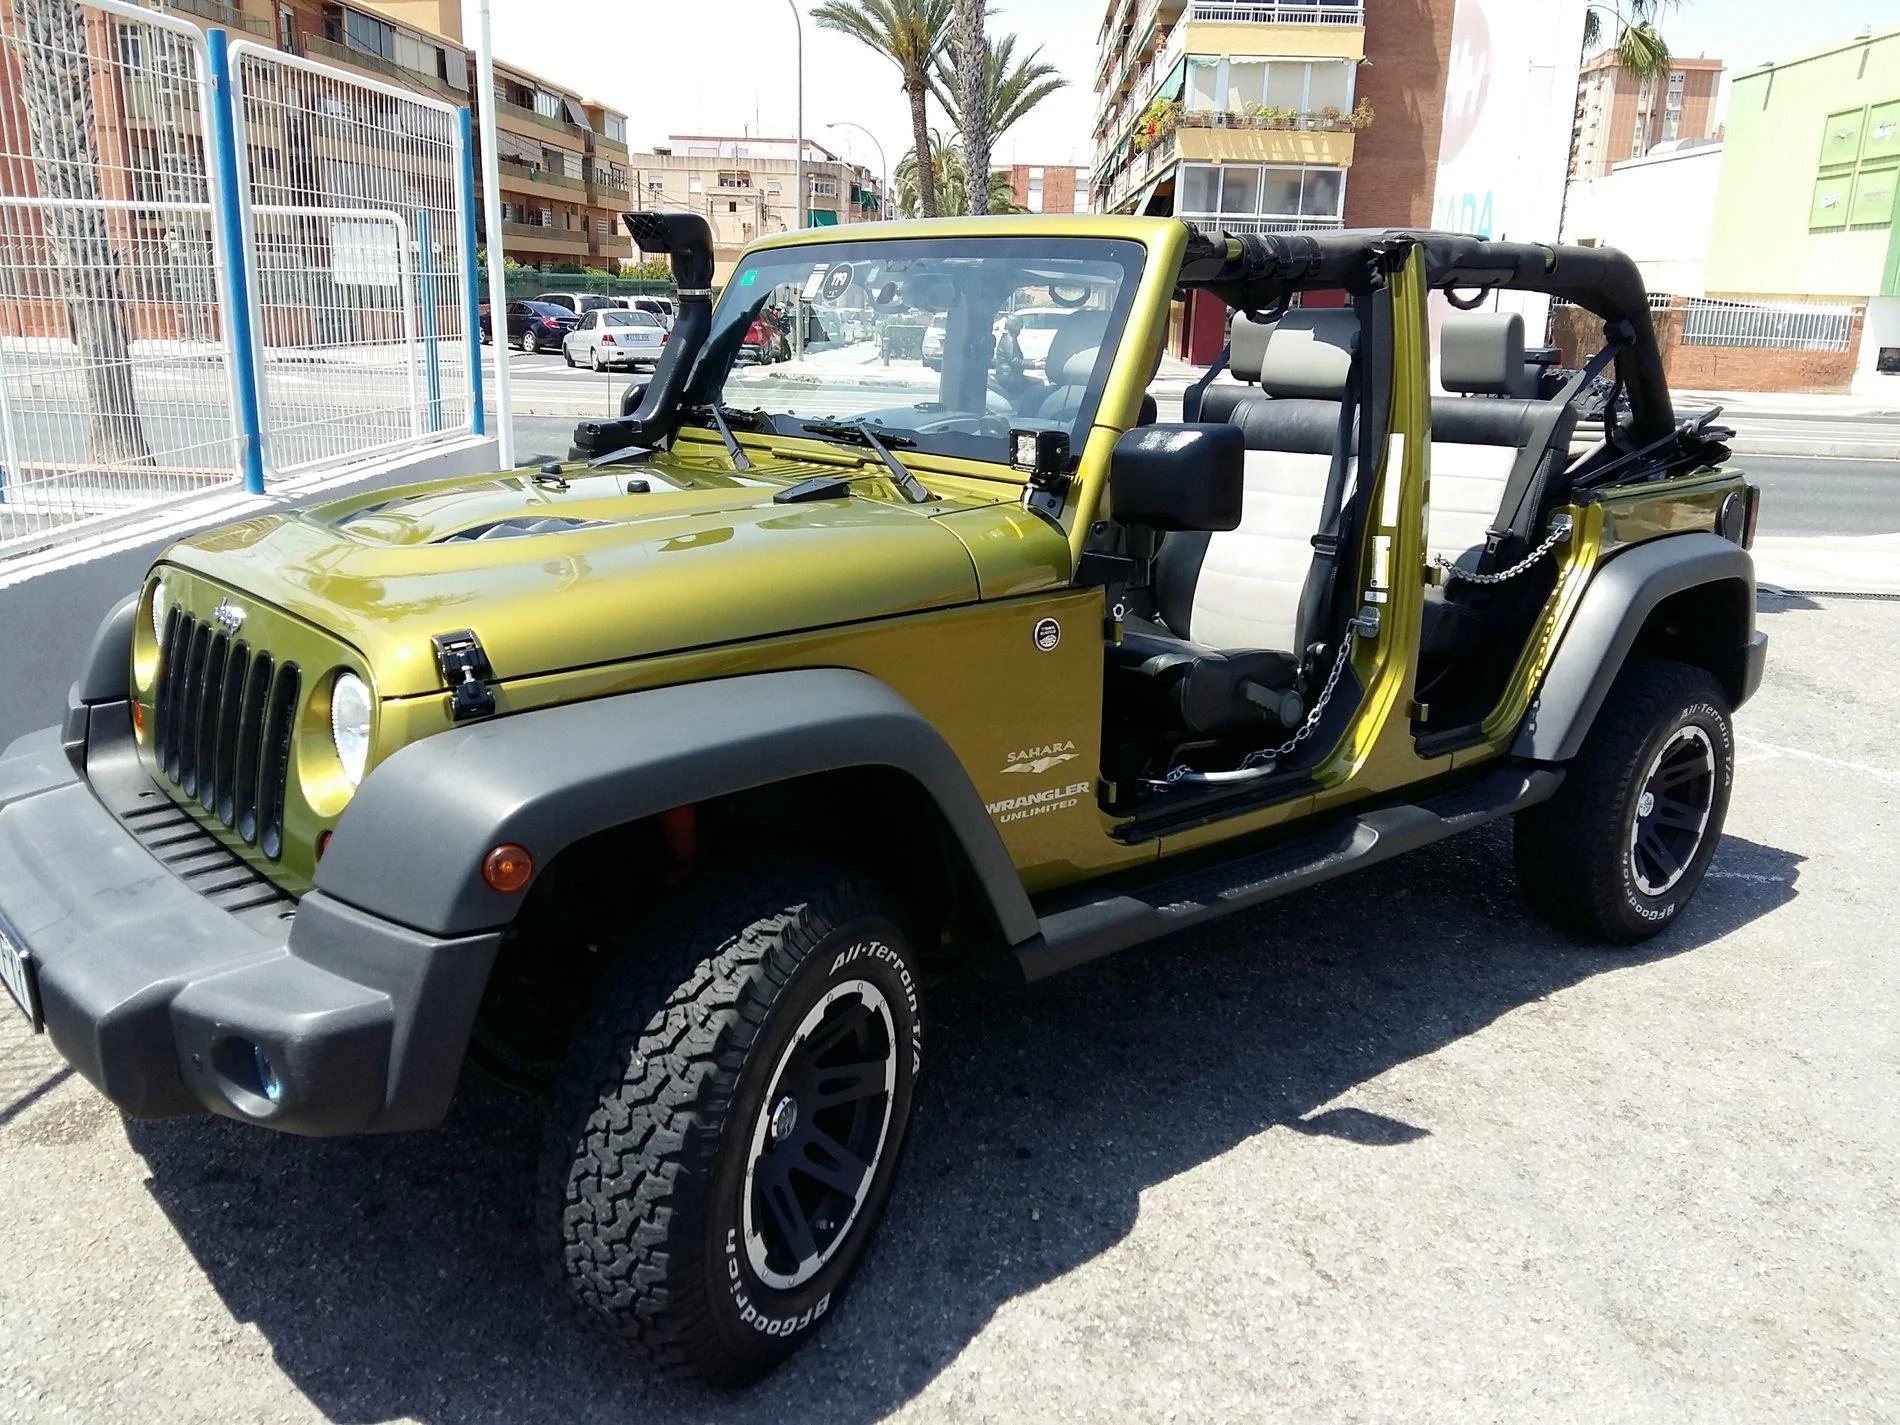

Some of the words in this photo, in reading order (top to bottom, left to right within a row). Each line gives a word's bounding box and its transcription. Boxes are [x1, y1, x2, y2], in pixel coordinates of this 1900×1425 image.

[1007, 740, 1076, 763] SAHARA
[1724, 753, 1732, 788] T/A
[985, 781, 1091, 815] WRANGLER
[1000, 798, 1078, 824] UNLIMITED
[1622, 851, 1676, 921] BFGoodrich
[912, 1019, 921, 1075] T/A
[725, 1228, 831, 1338] BFGoodrich
